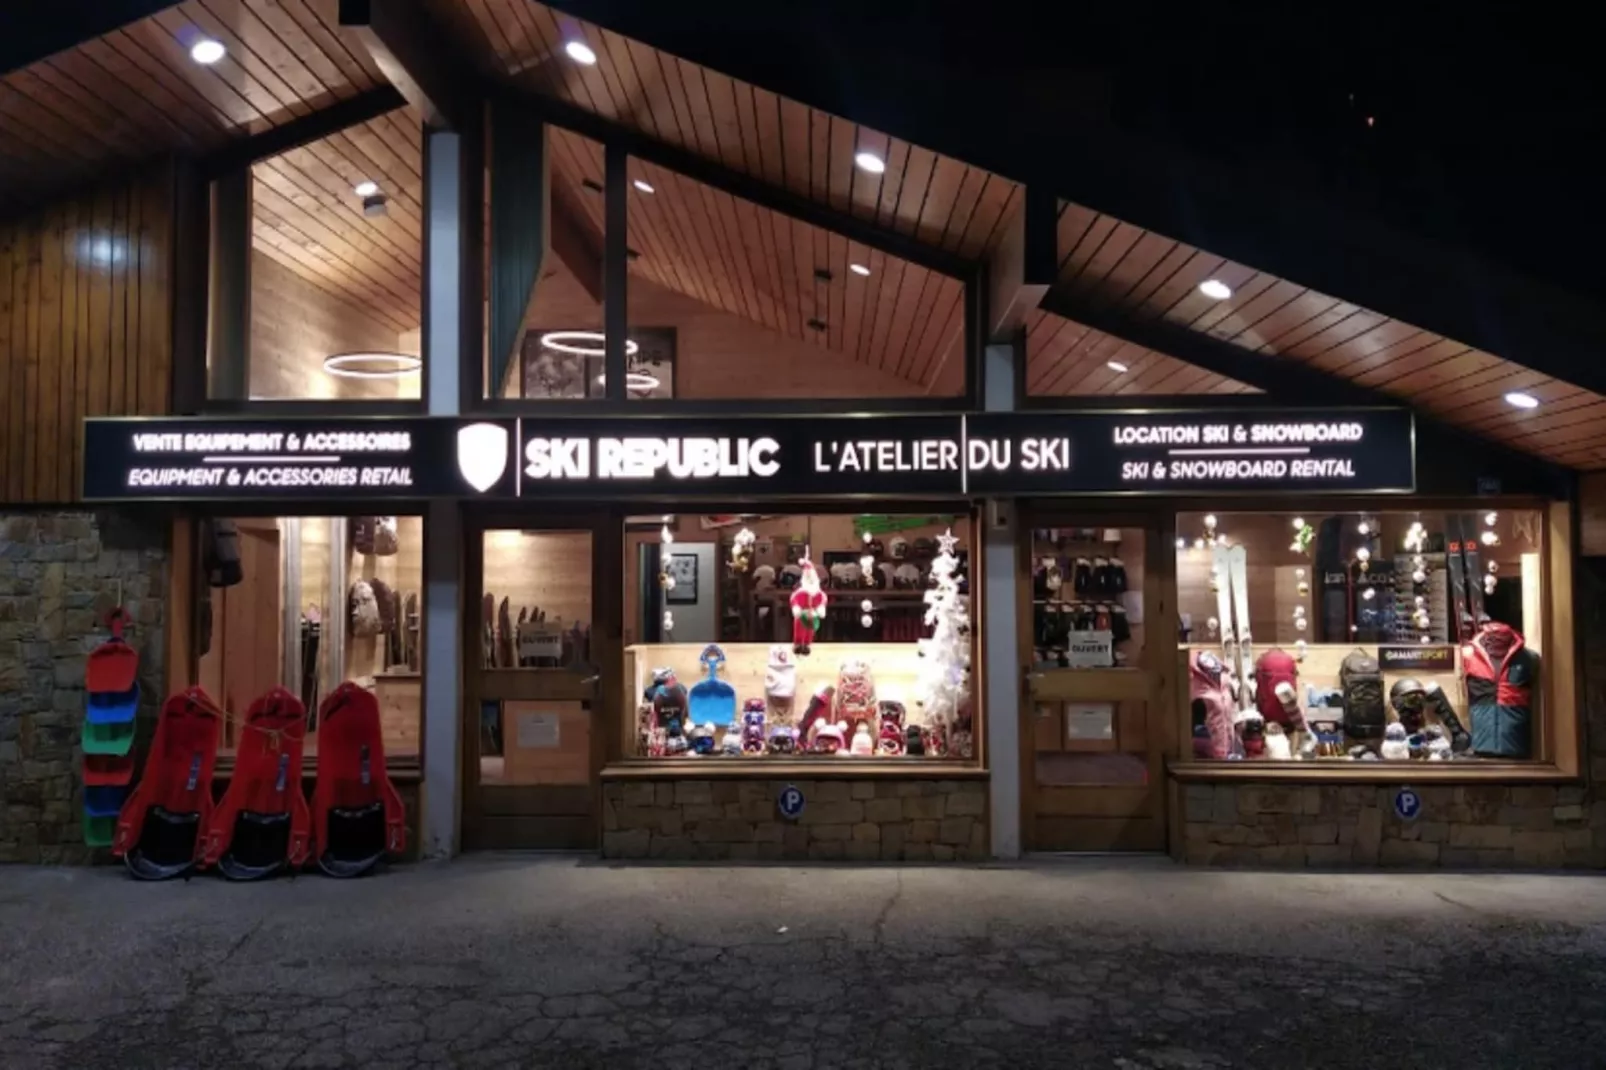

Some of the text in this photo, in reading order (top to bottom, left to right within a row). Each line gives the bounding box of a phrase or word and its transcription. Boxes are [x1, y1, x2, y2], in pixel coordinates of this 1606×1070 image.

[131, 431, 411, 452] VENTE EQUIPEMENT & ACCESSOIRES
[1113, 423, 1364, 444] LOCATION SKI & SNOWBOARD
[524, 437, 781, 479] SKI REPUBLIC
[814, 438, 1070, 472] L'ATELIER DU SKI
[127, 467, 413, 487] EQUIPMENT & ACCESSORIES RETAIL
[1121, 459, 1356, 480] SKI & SNOWBOARD RENTAL
[786, 790, 801, 811] P
[1401, 792, 1416, 813] P
